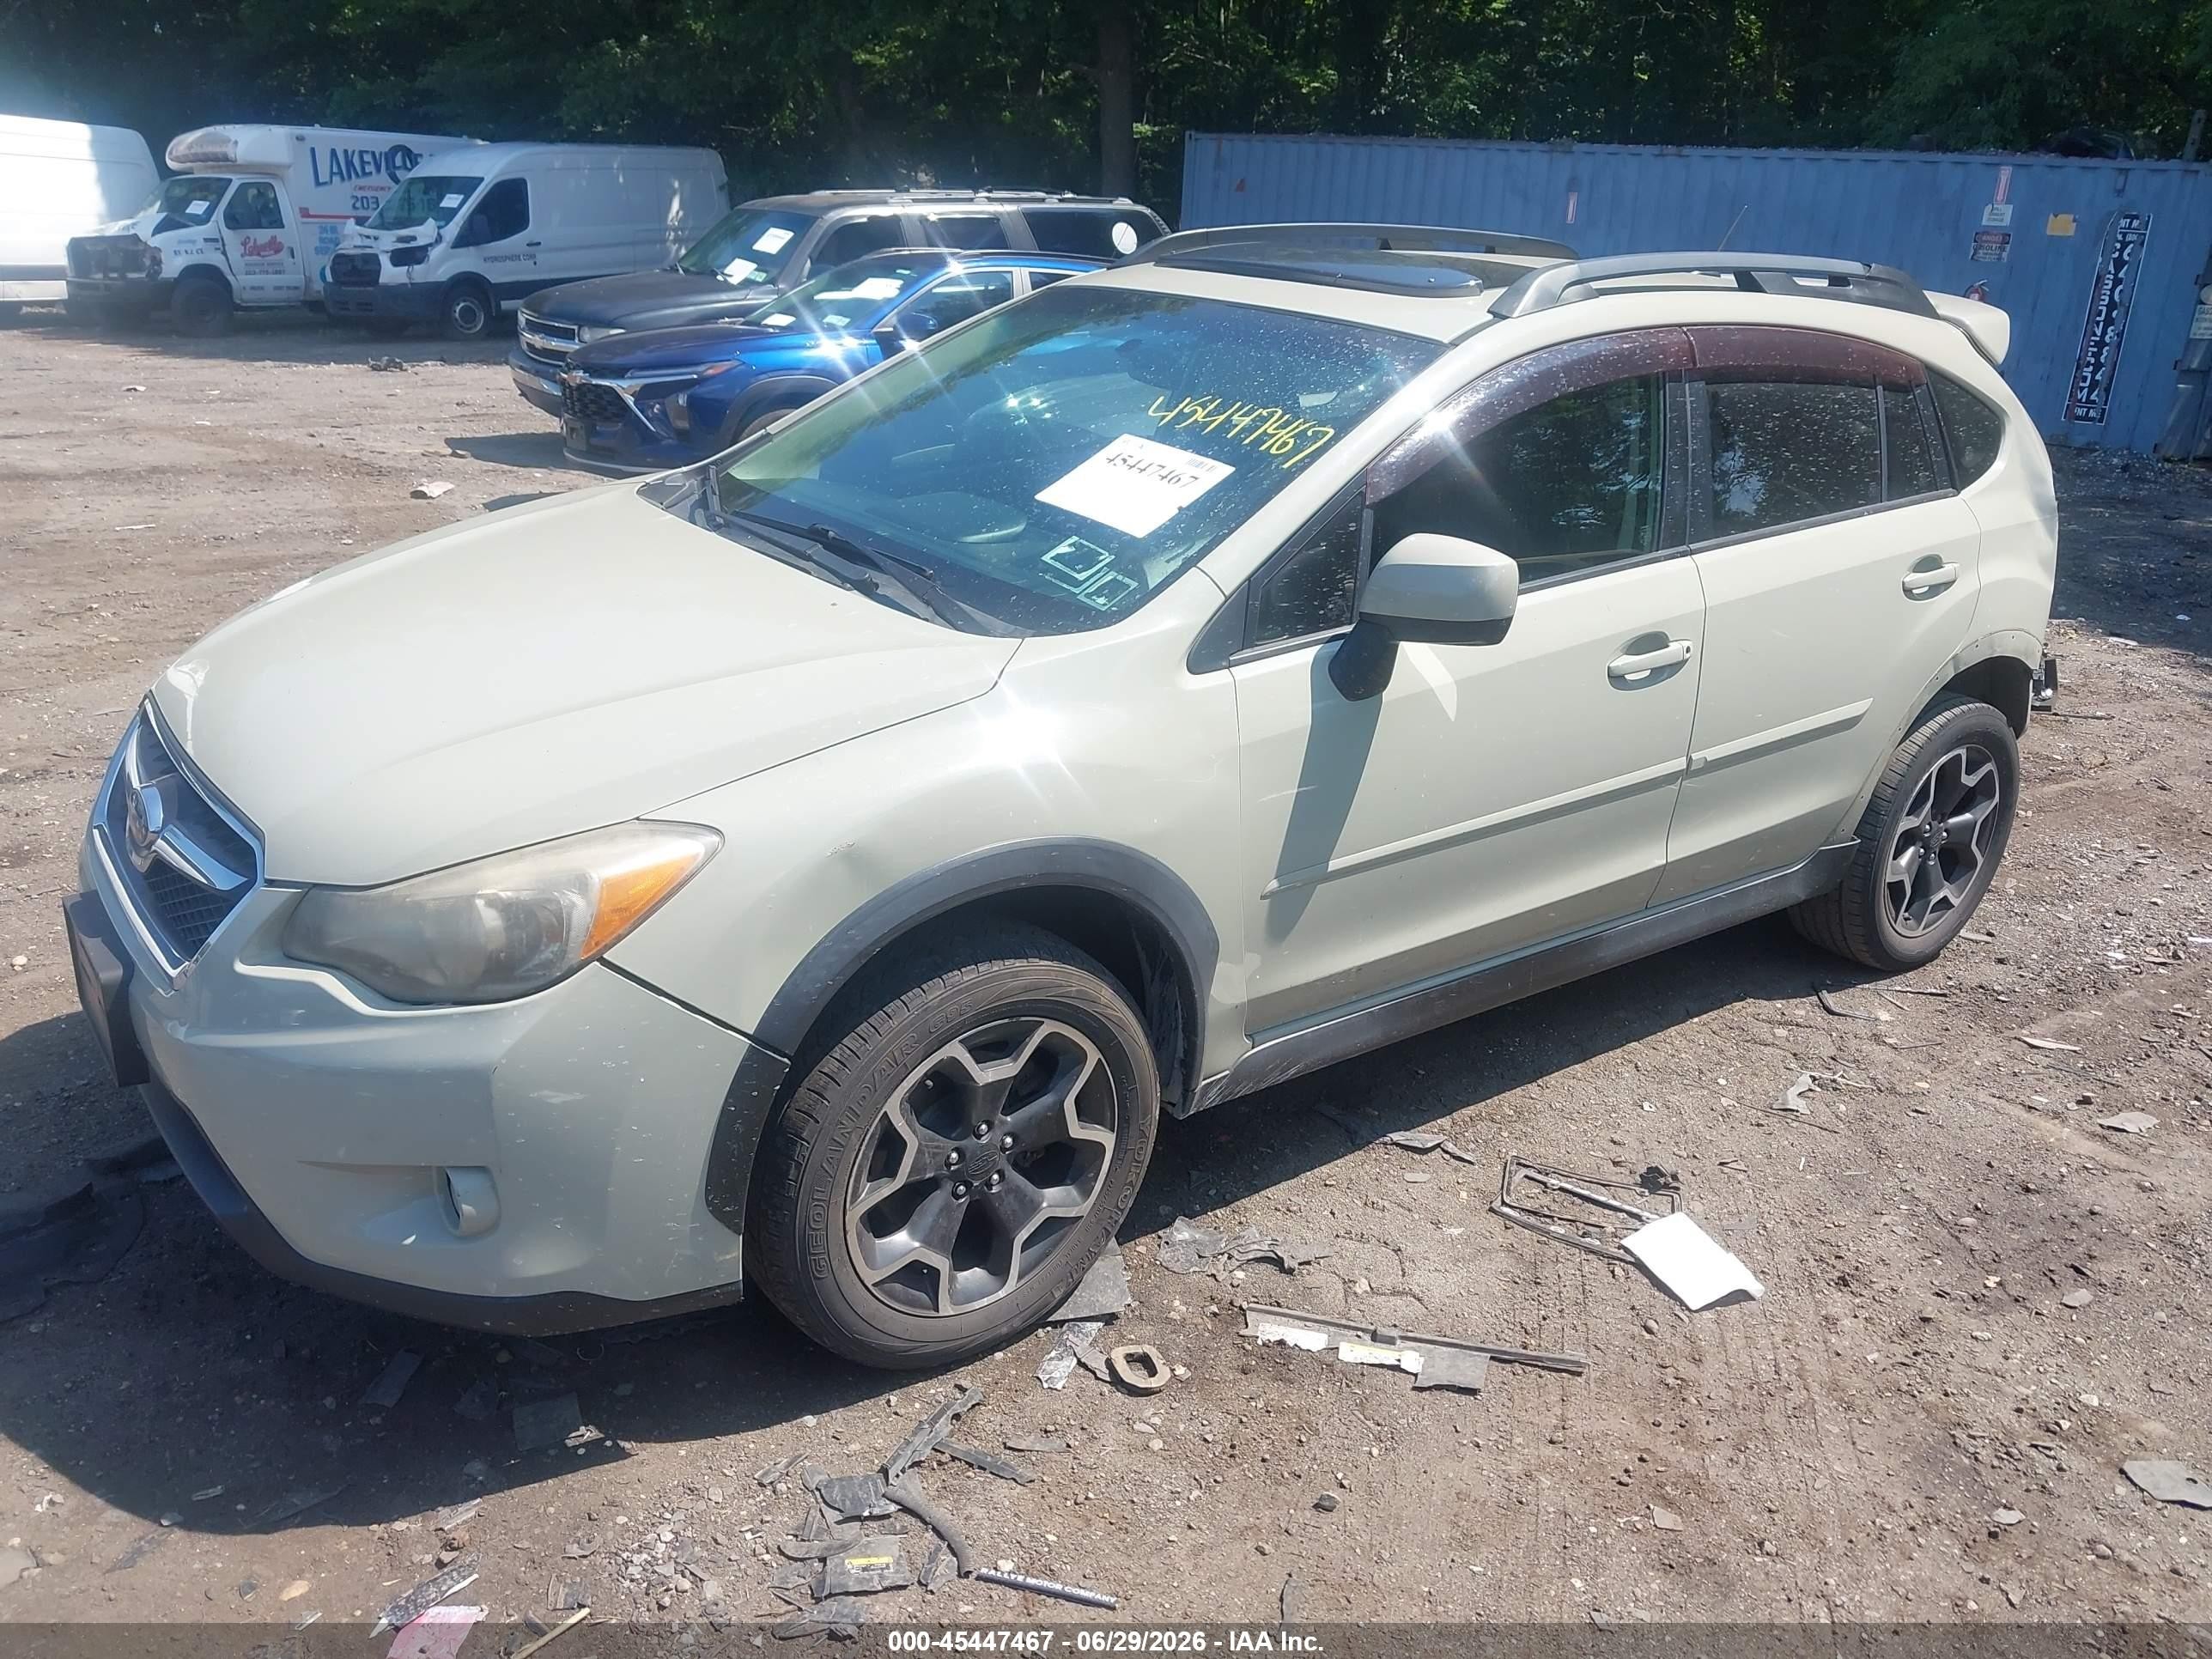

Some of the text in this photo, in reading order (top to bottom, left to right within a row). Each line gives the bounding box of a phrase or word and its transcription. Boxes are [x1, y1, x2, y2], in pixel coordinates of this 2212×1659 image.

[351, 195, 380, 211] 203
[1148, 396, 1334, 469] 45447467
[1106, 453, 1200, 488] 45447467
[981, 1568, 1117, 1603] RALLYE MOTOR COMPANY
